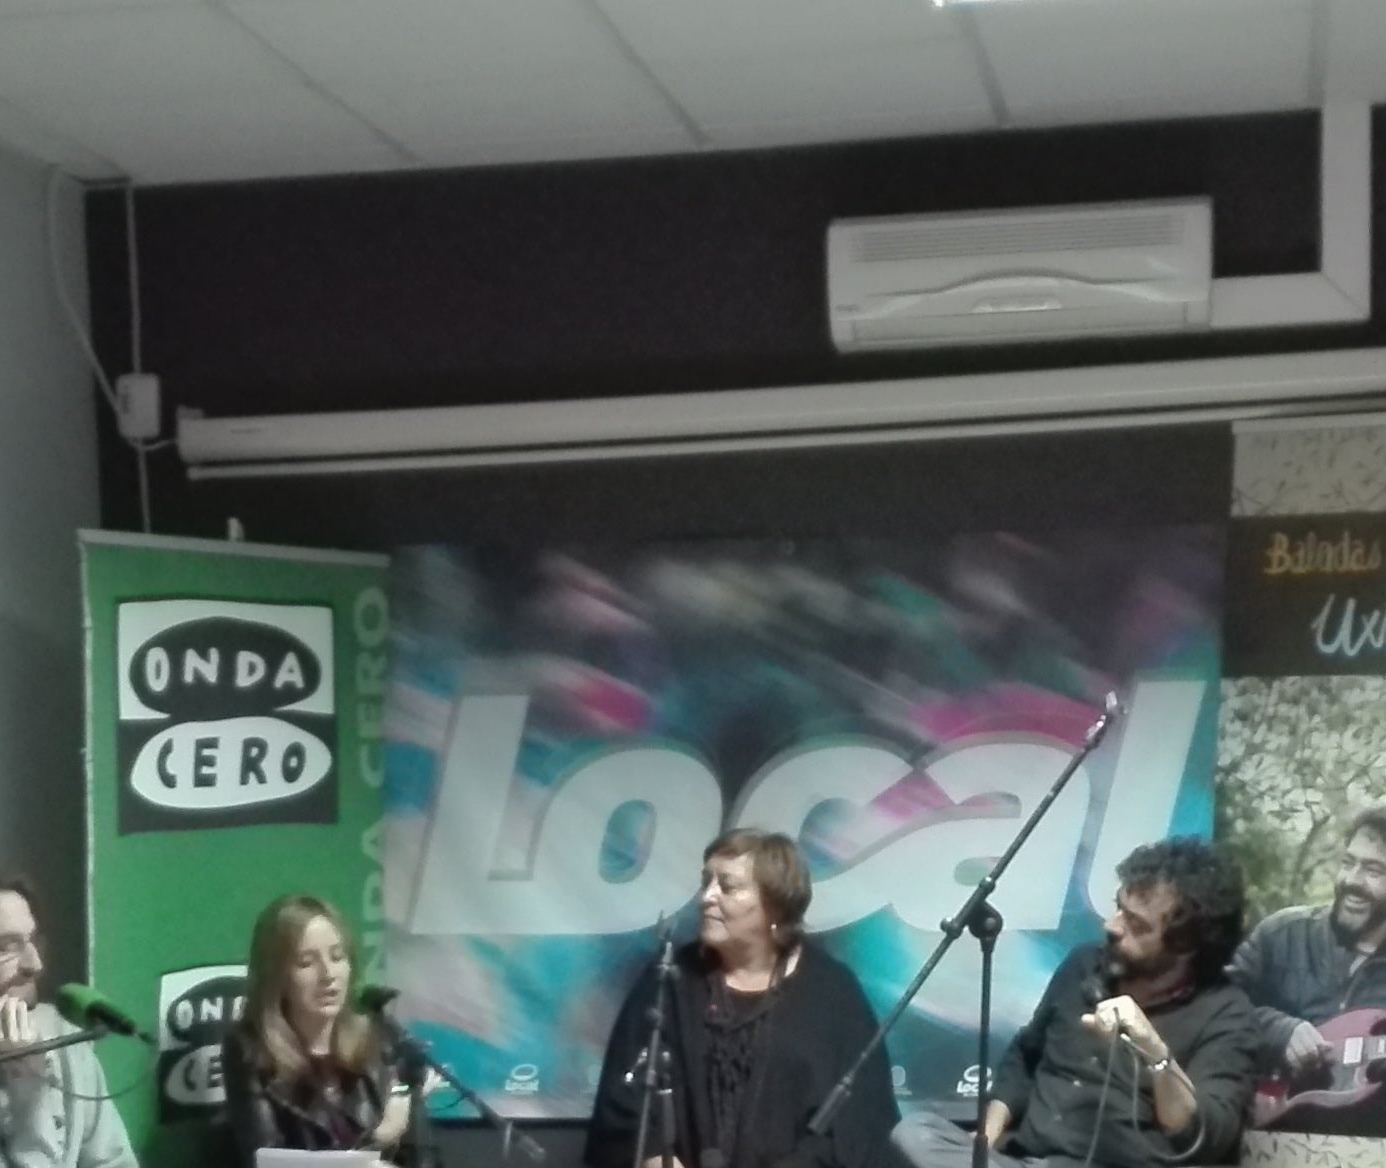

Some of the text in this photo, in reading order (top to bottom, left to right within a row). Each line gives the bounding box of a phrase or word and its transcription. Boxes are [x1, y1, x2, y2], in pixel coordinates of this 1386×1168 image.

[144, 646, 306, 692] ONDA
[157, 736, 308, 789] CERO
[354, 586, 388, 985] NDA CERO
[410, 678, 1208, 937] Local
[175, 995, 247, 1030] OND
[183, 1057, 223, 1092] CE
[956, 1080, 994, 1094] Locl
